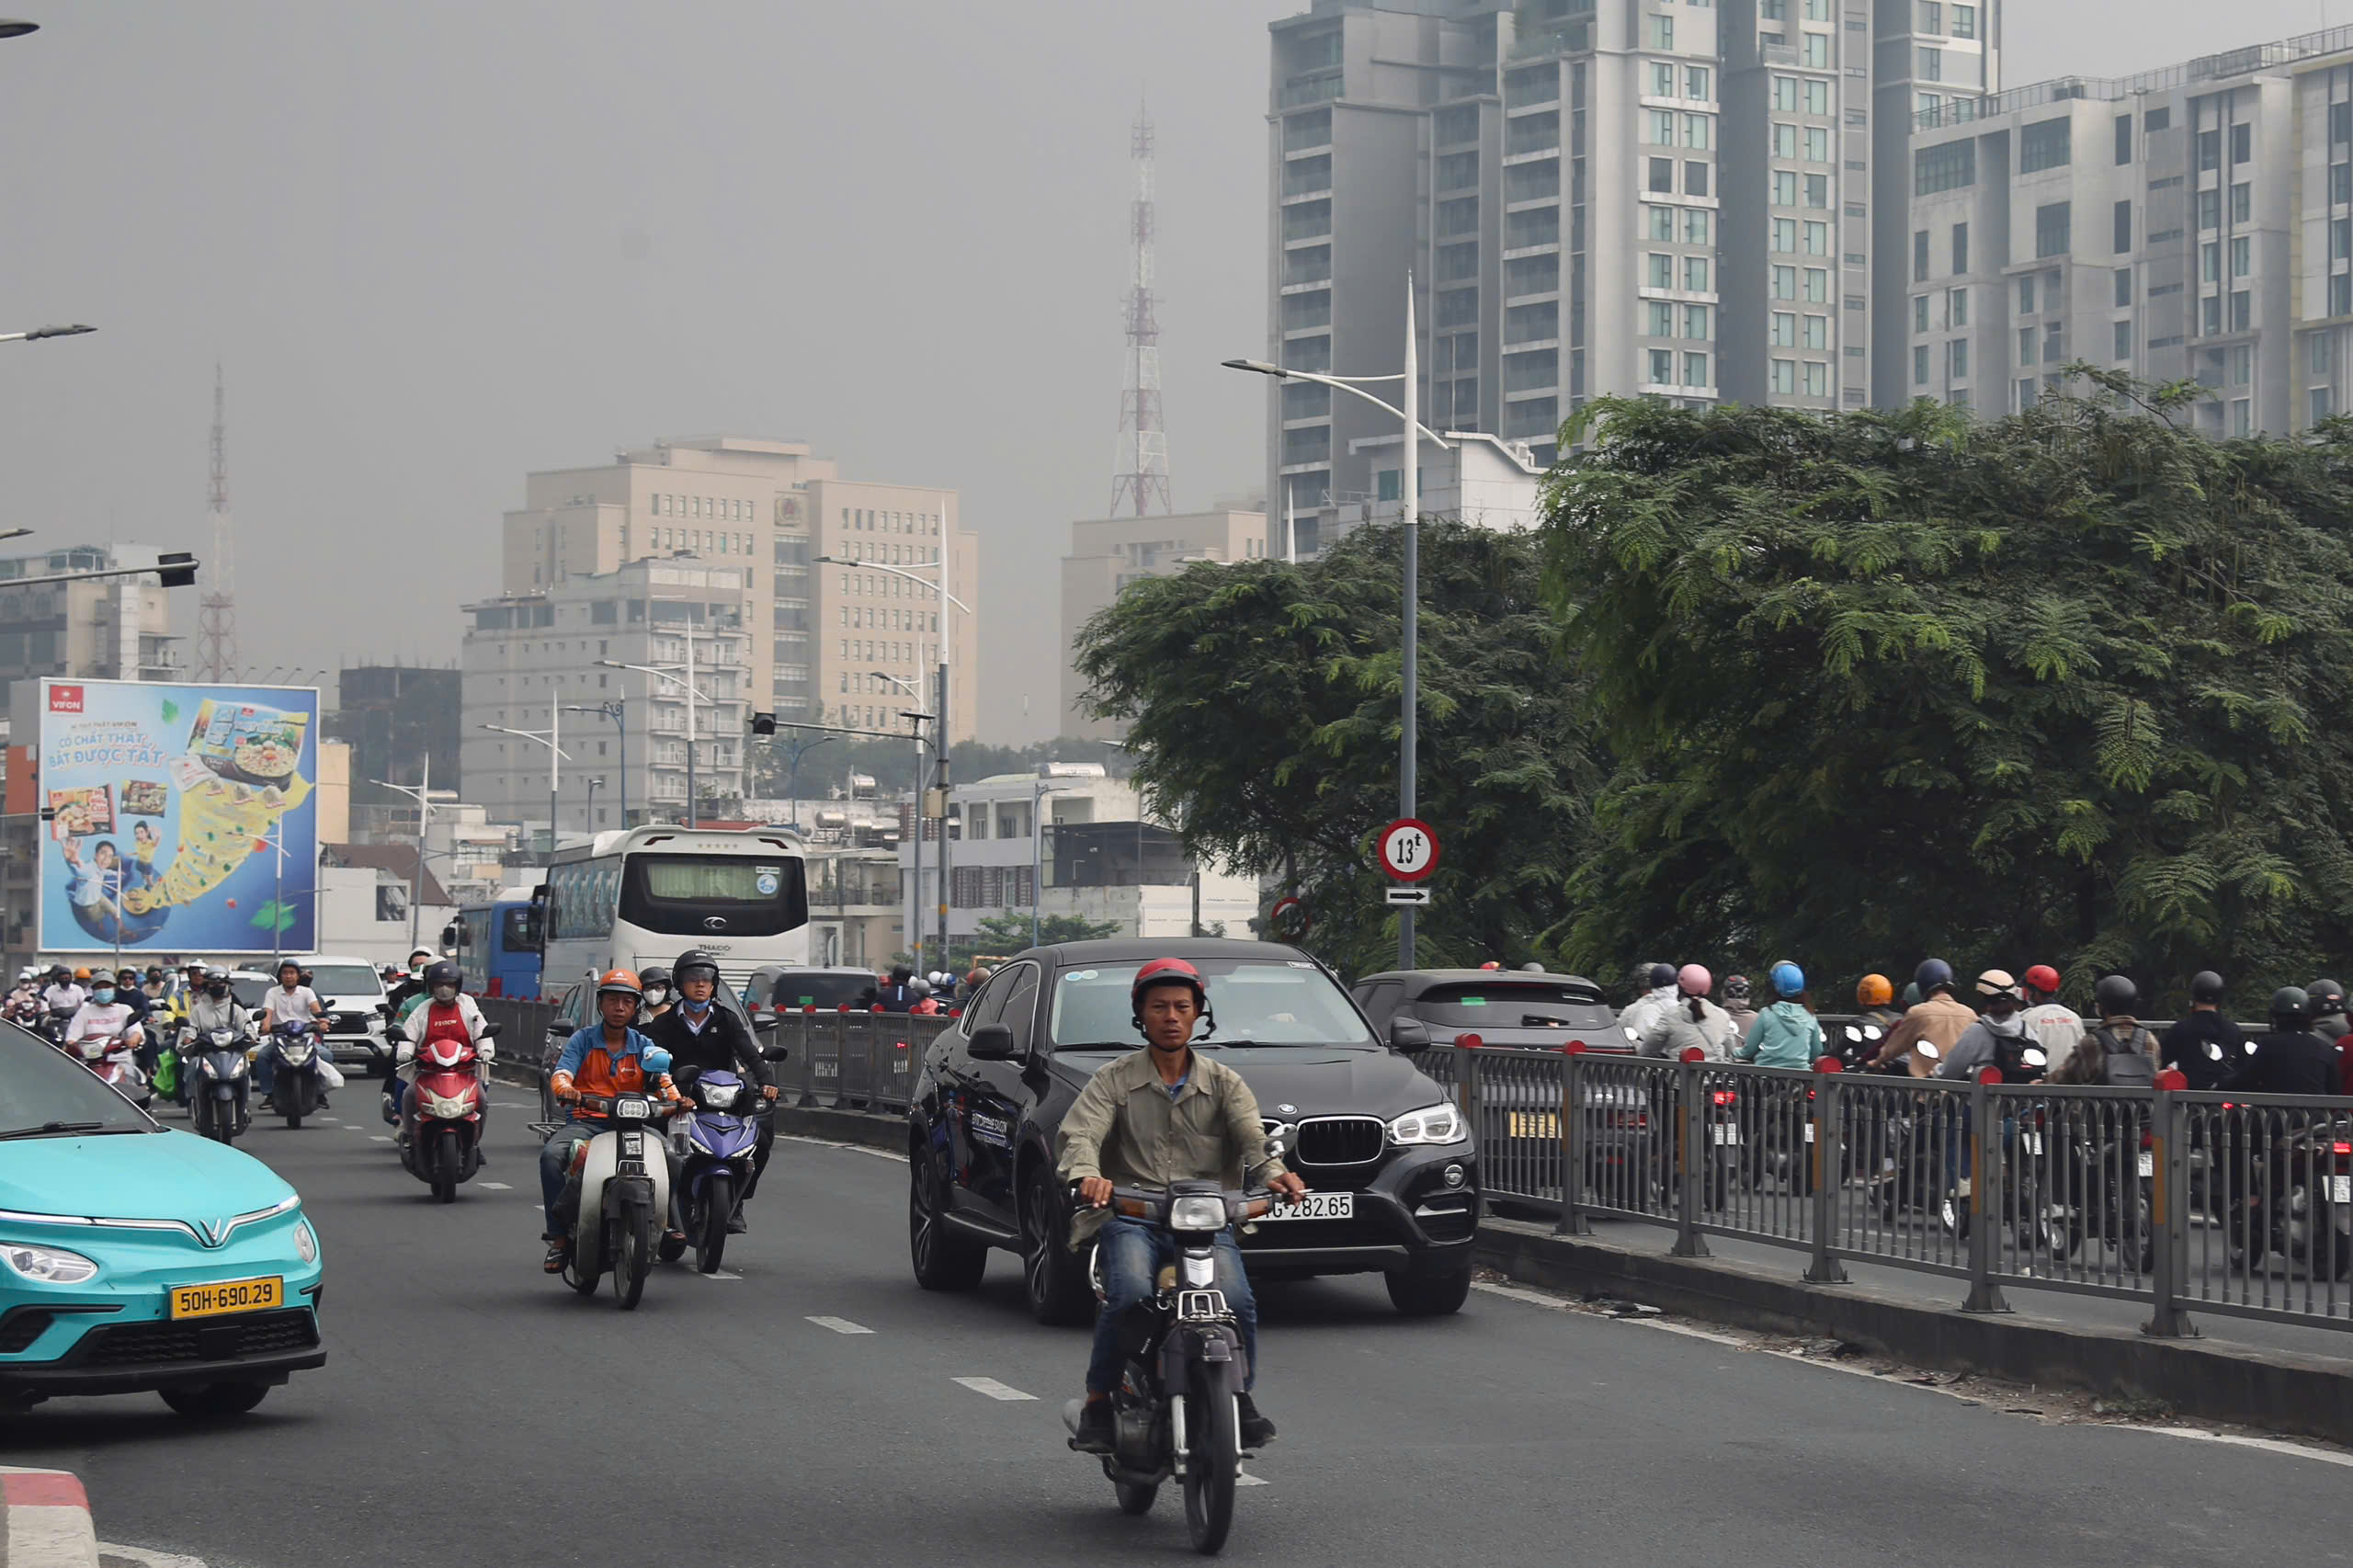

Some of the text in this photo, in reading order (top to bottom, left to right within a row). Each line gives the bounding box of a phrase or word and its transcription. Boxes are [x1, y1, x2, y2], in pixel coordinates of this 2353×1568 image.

[52, 701, 81, 710] VIFON
[1266, 1196, 1349, 1218] G-282.65
[181, 1283, 272, 1312] 50H-690.29
